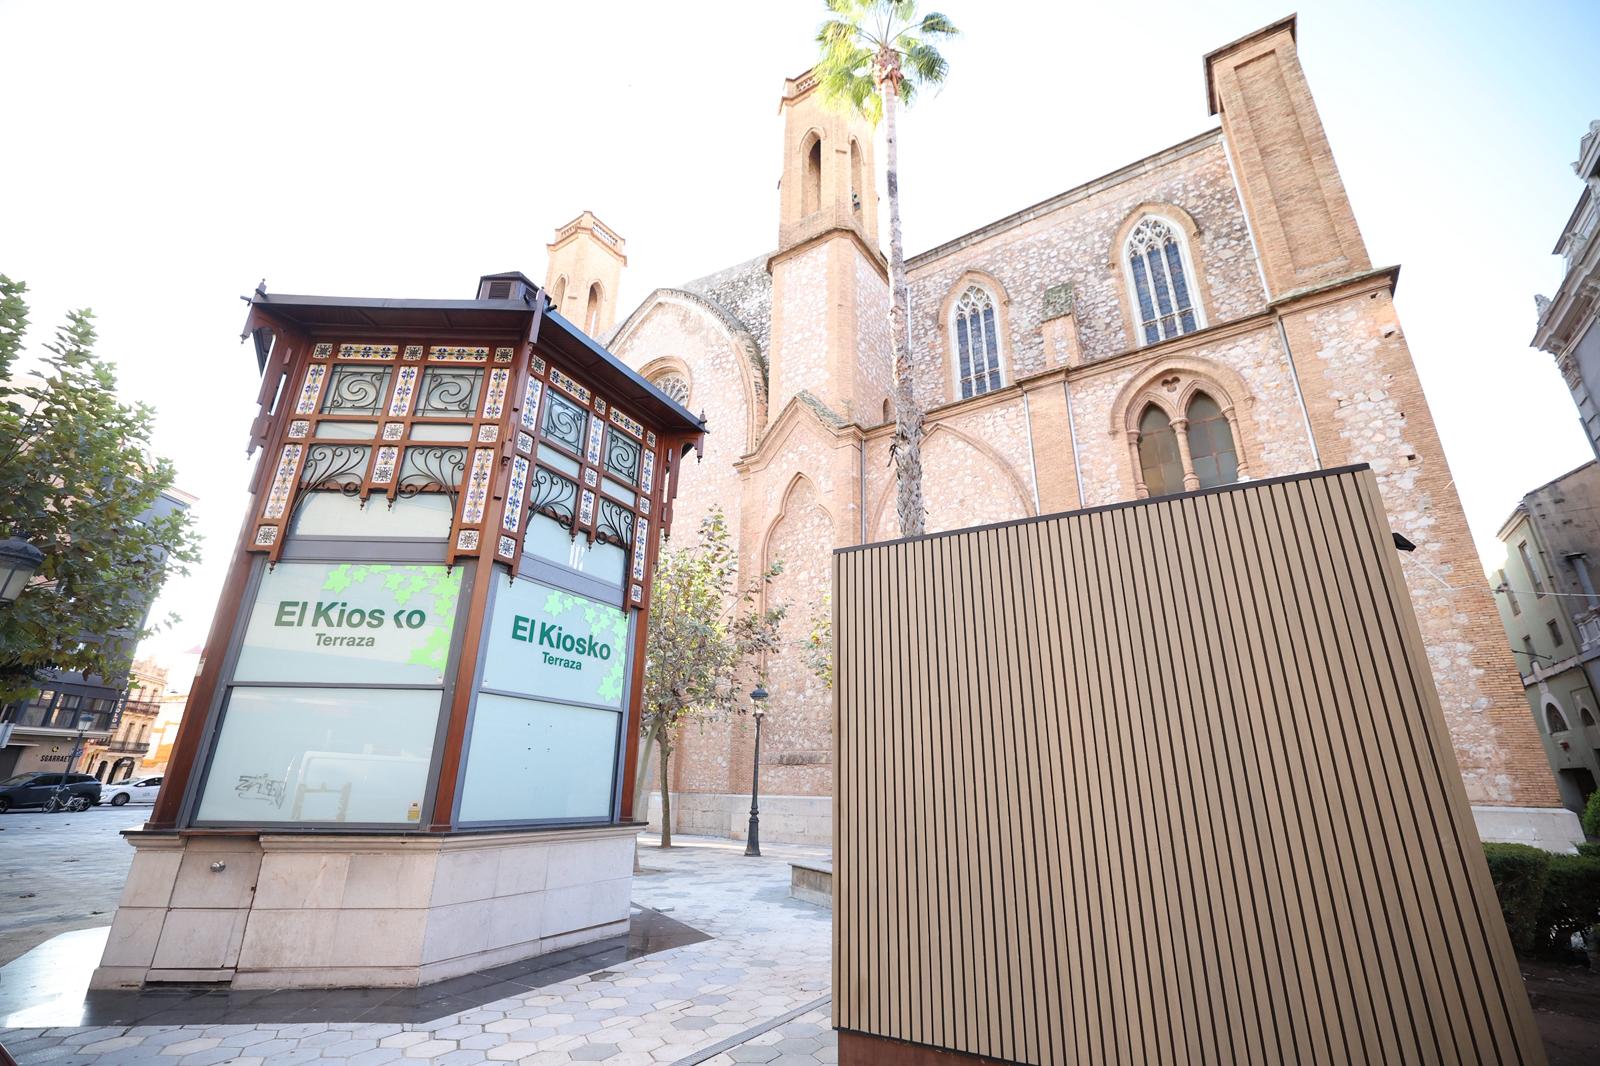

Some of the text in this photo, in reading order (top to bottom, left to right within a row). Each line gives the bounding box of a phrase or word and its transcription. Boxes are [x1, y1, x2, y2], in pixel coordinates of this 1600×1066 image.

[274, 601, 309, 627] El
[315, 633, 376, 647] Terraza
[511, 614, 611, 661] El Kiosko
[542, 651, 582, 671] Terraza
